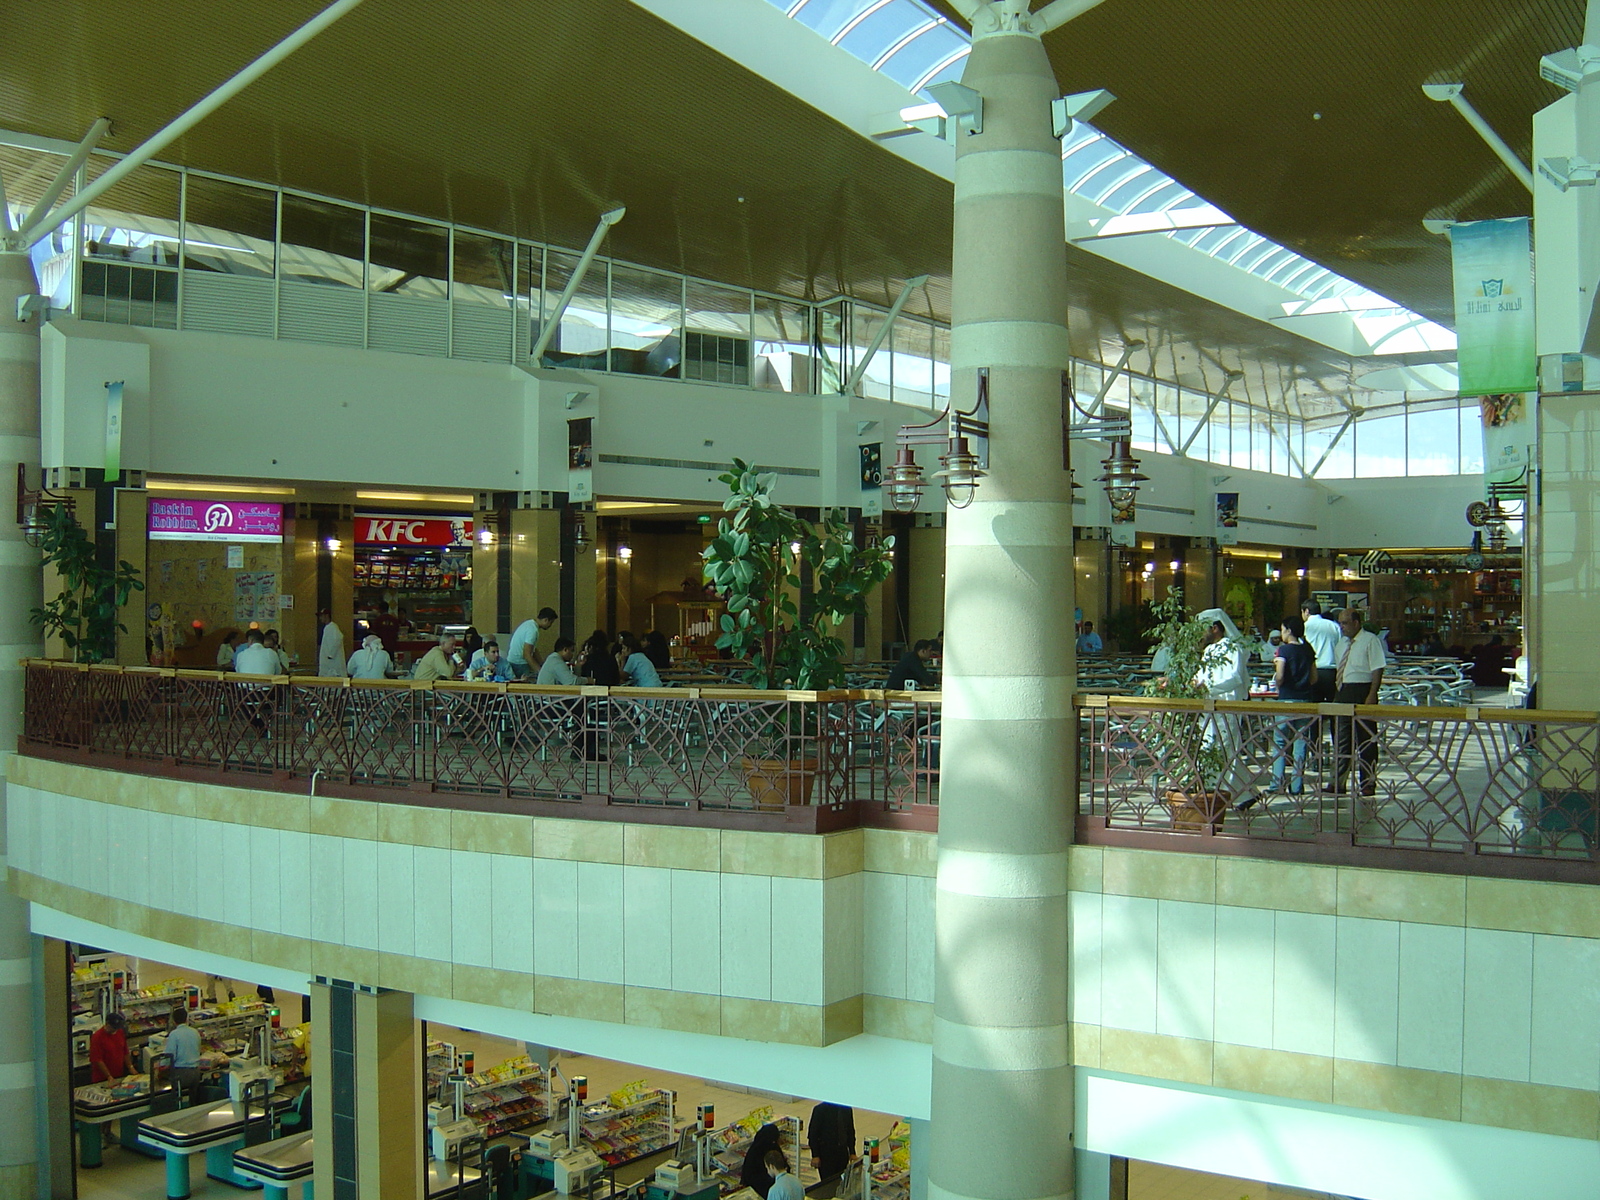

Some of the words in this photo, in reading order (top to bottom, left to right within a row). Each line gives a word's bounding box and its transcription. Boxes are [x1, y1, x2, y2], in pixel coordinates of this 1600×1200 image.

[152, 503, 193, 516] Baskin
[204, 511, 228, 531] 31
[366, 520, 426, 543] KFC
